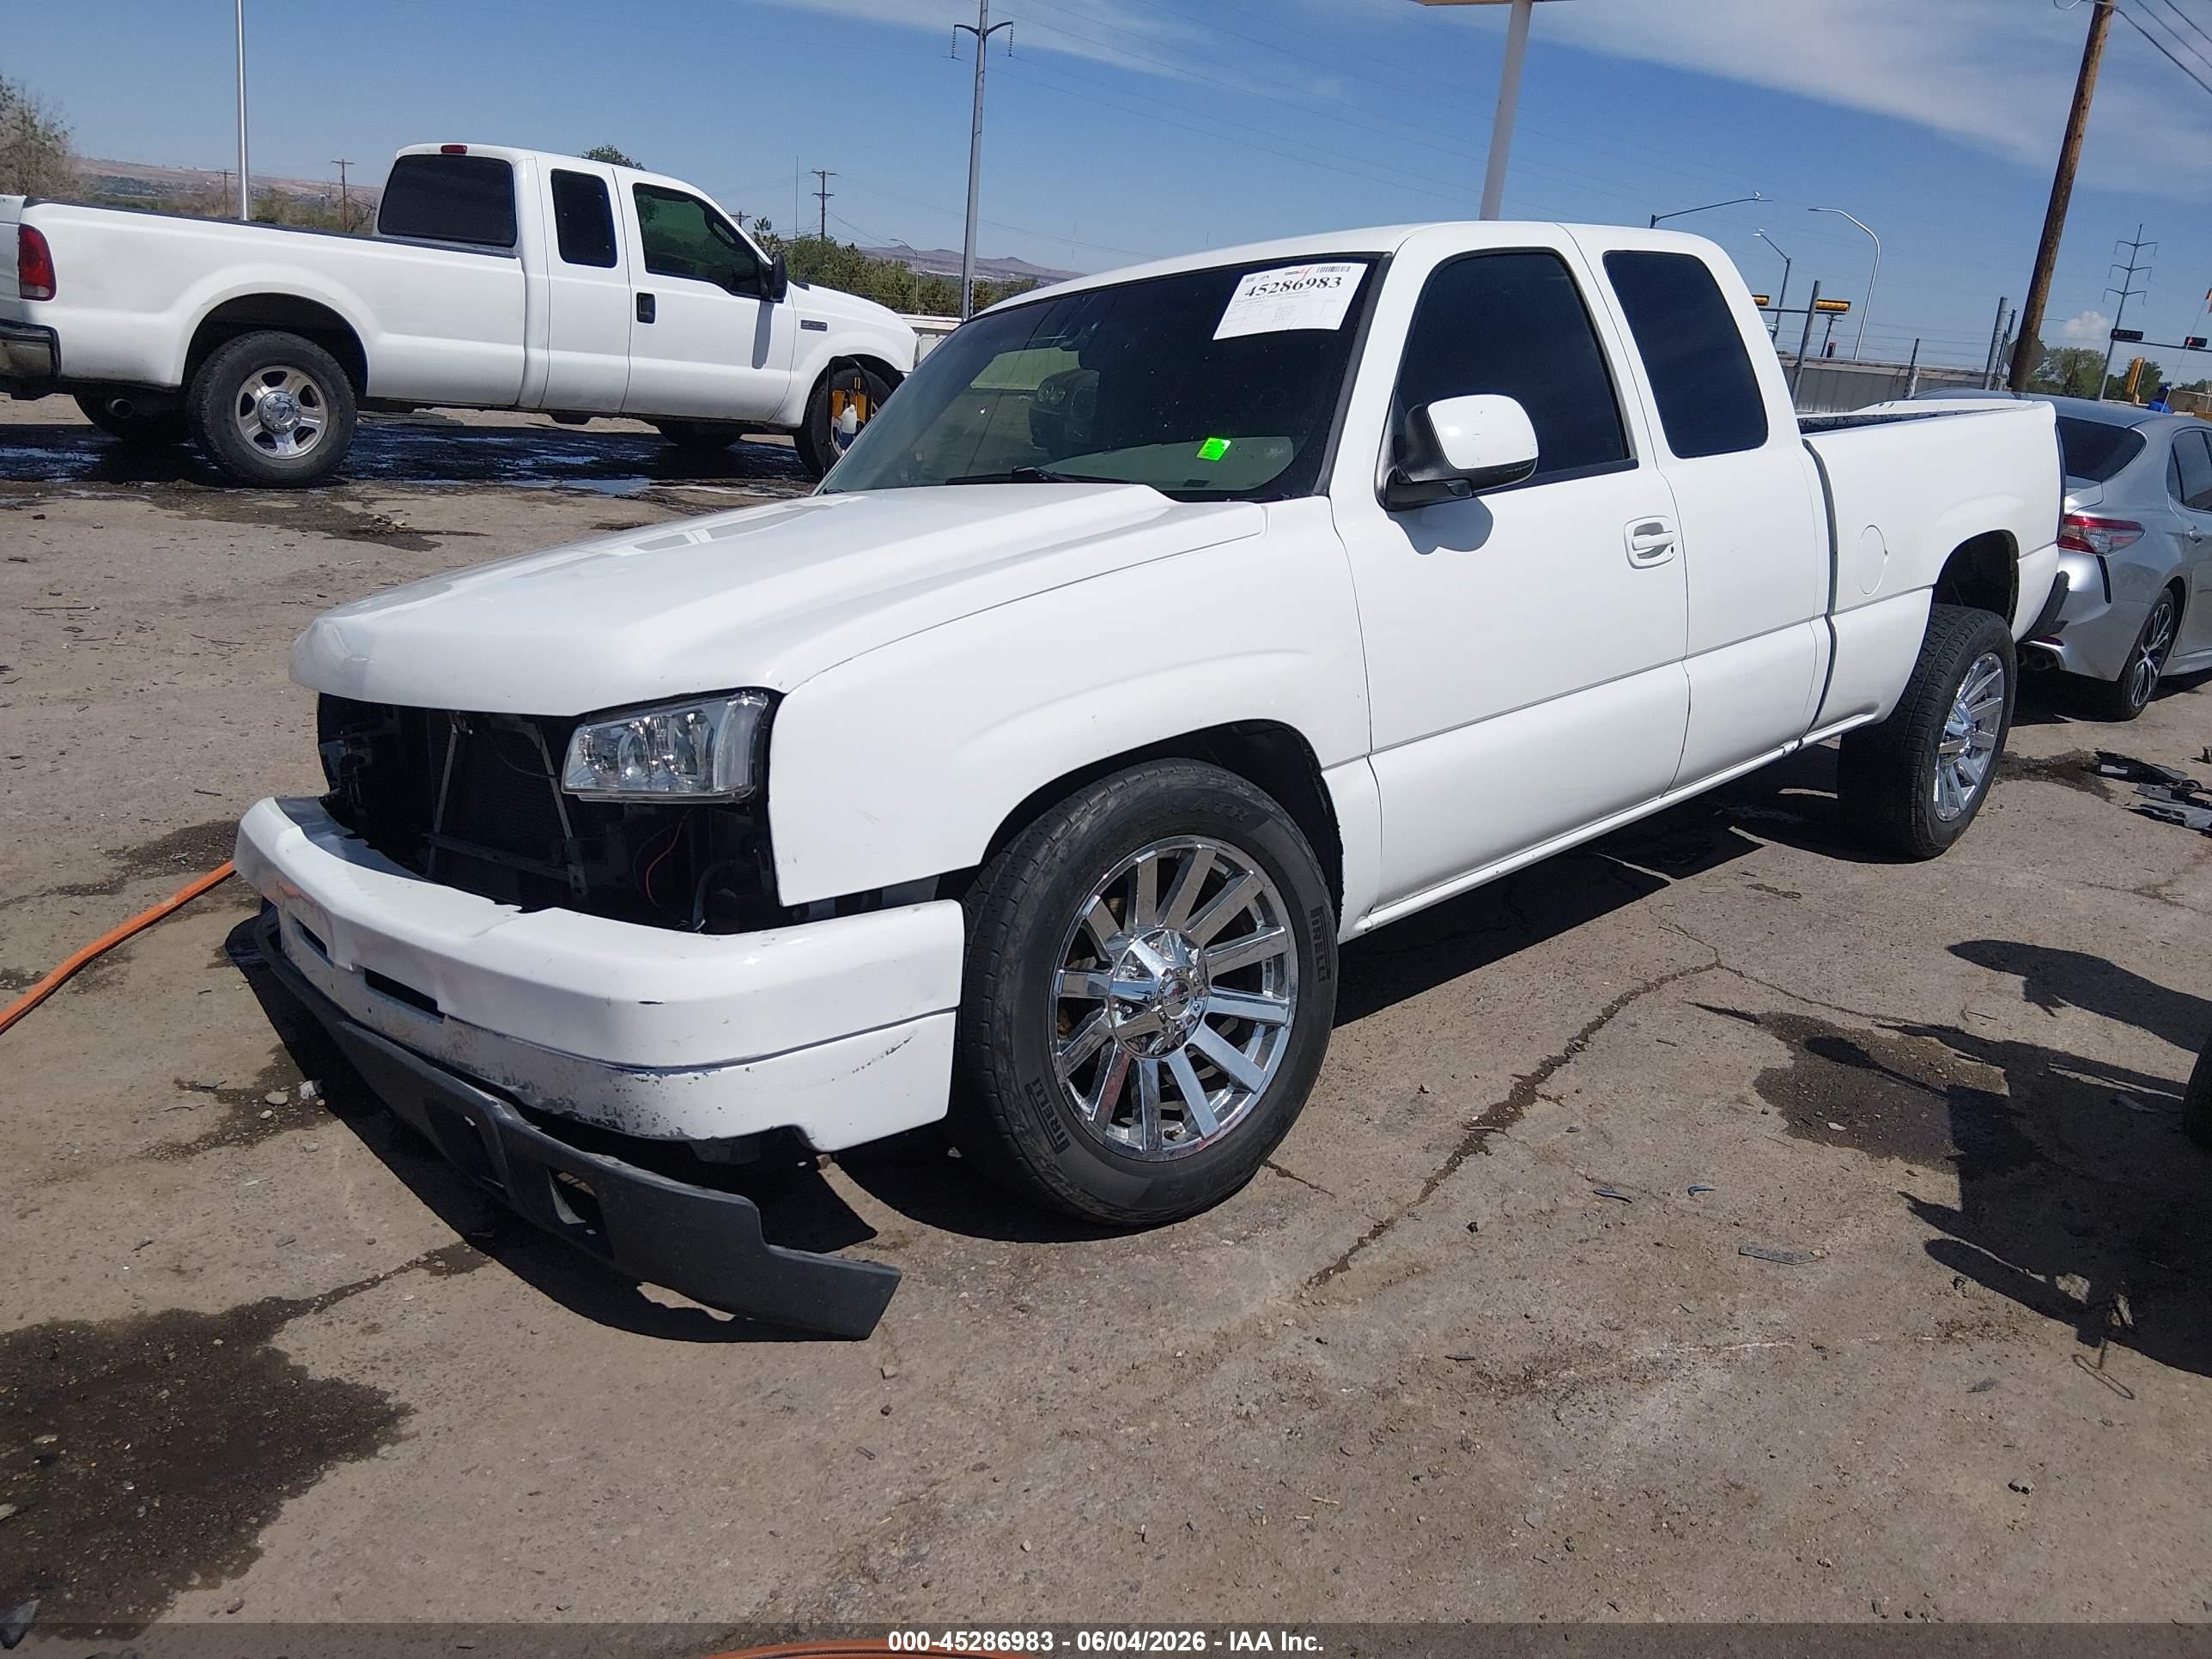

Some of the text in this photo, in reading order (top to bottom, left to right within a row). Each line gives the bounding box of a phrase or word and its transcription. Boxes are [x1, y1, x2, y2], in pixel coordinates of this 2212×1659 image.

[1244, 276, 1342, 297] 45286983
[1310, 905, 1330, 982] PIRELLI
[1024, 1077, 1071, 1155] PIRELLI
